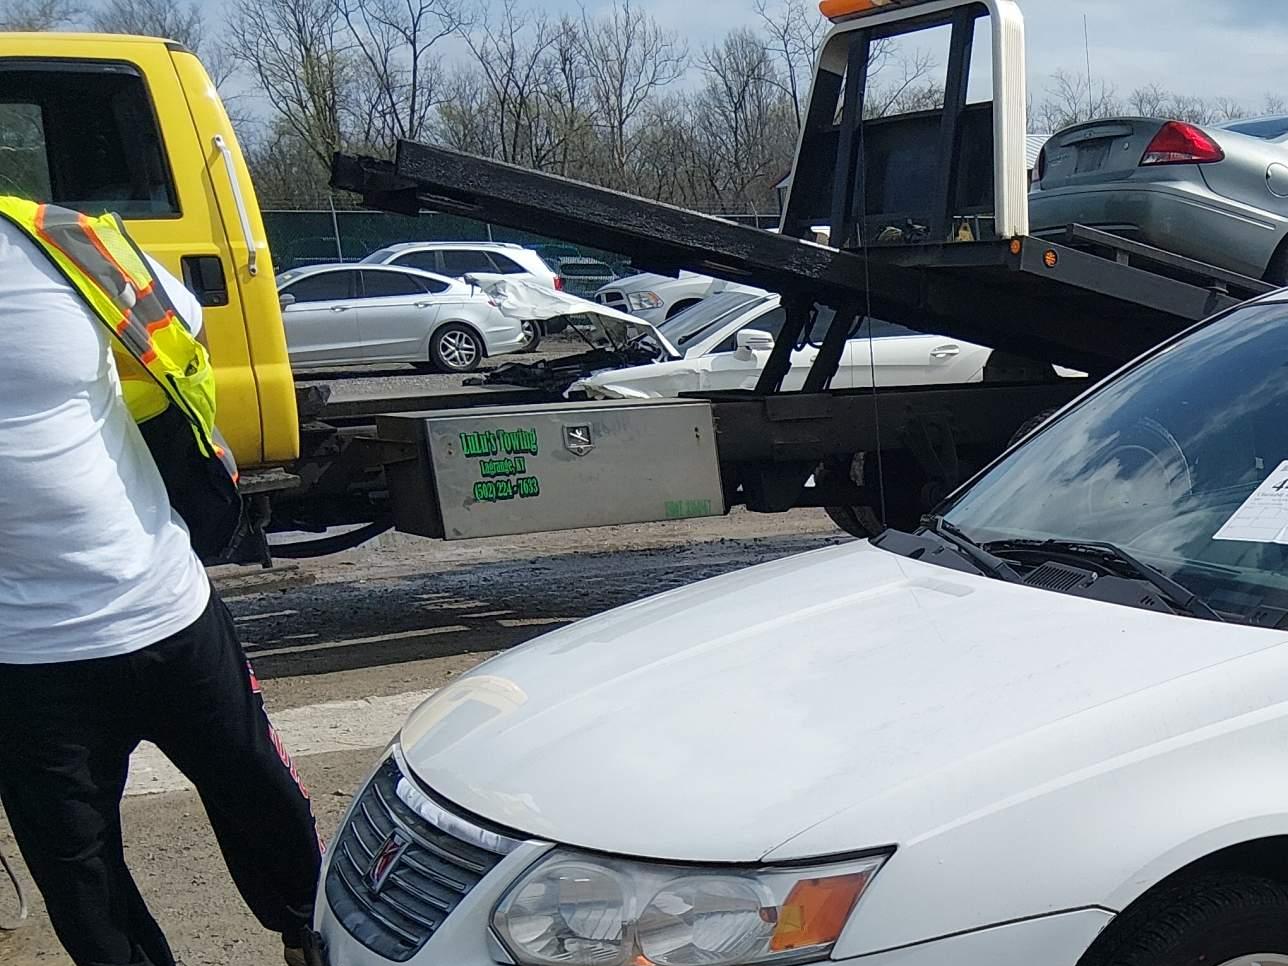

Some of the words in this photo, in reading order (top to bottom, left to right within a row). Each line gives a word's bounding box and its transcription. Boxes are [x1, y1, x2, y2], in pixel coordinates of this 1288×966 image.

[496, 428, 539, 456] Towing
[474, 481, 497, 503] (502)
[496, 479, 515, 500] 224
